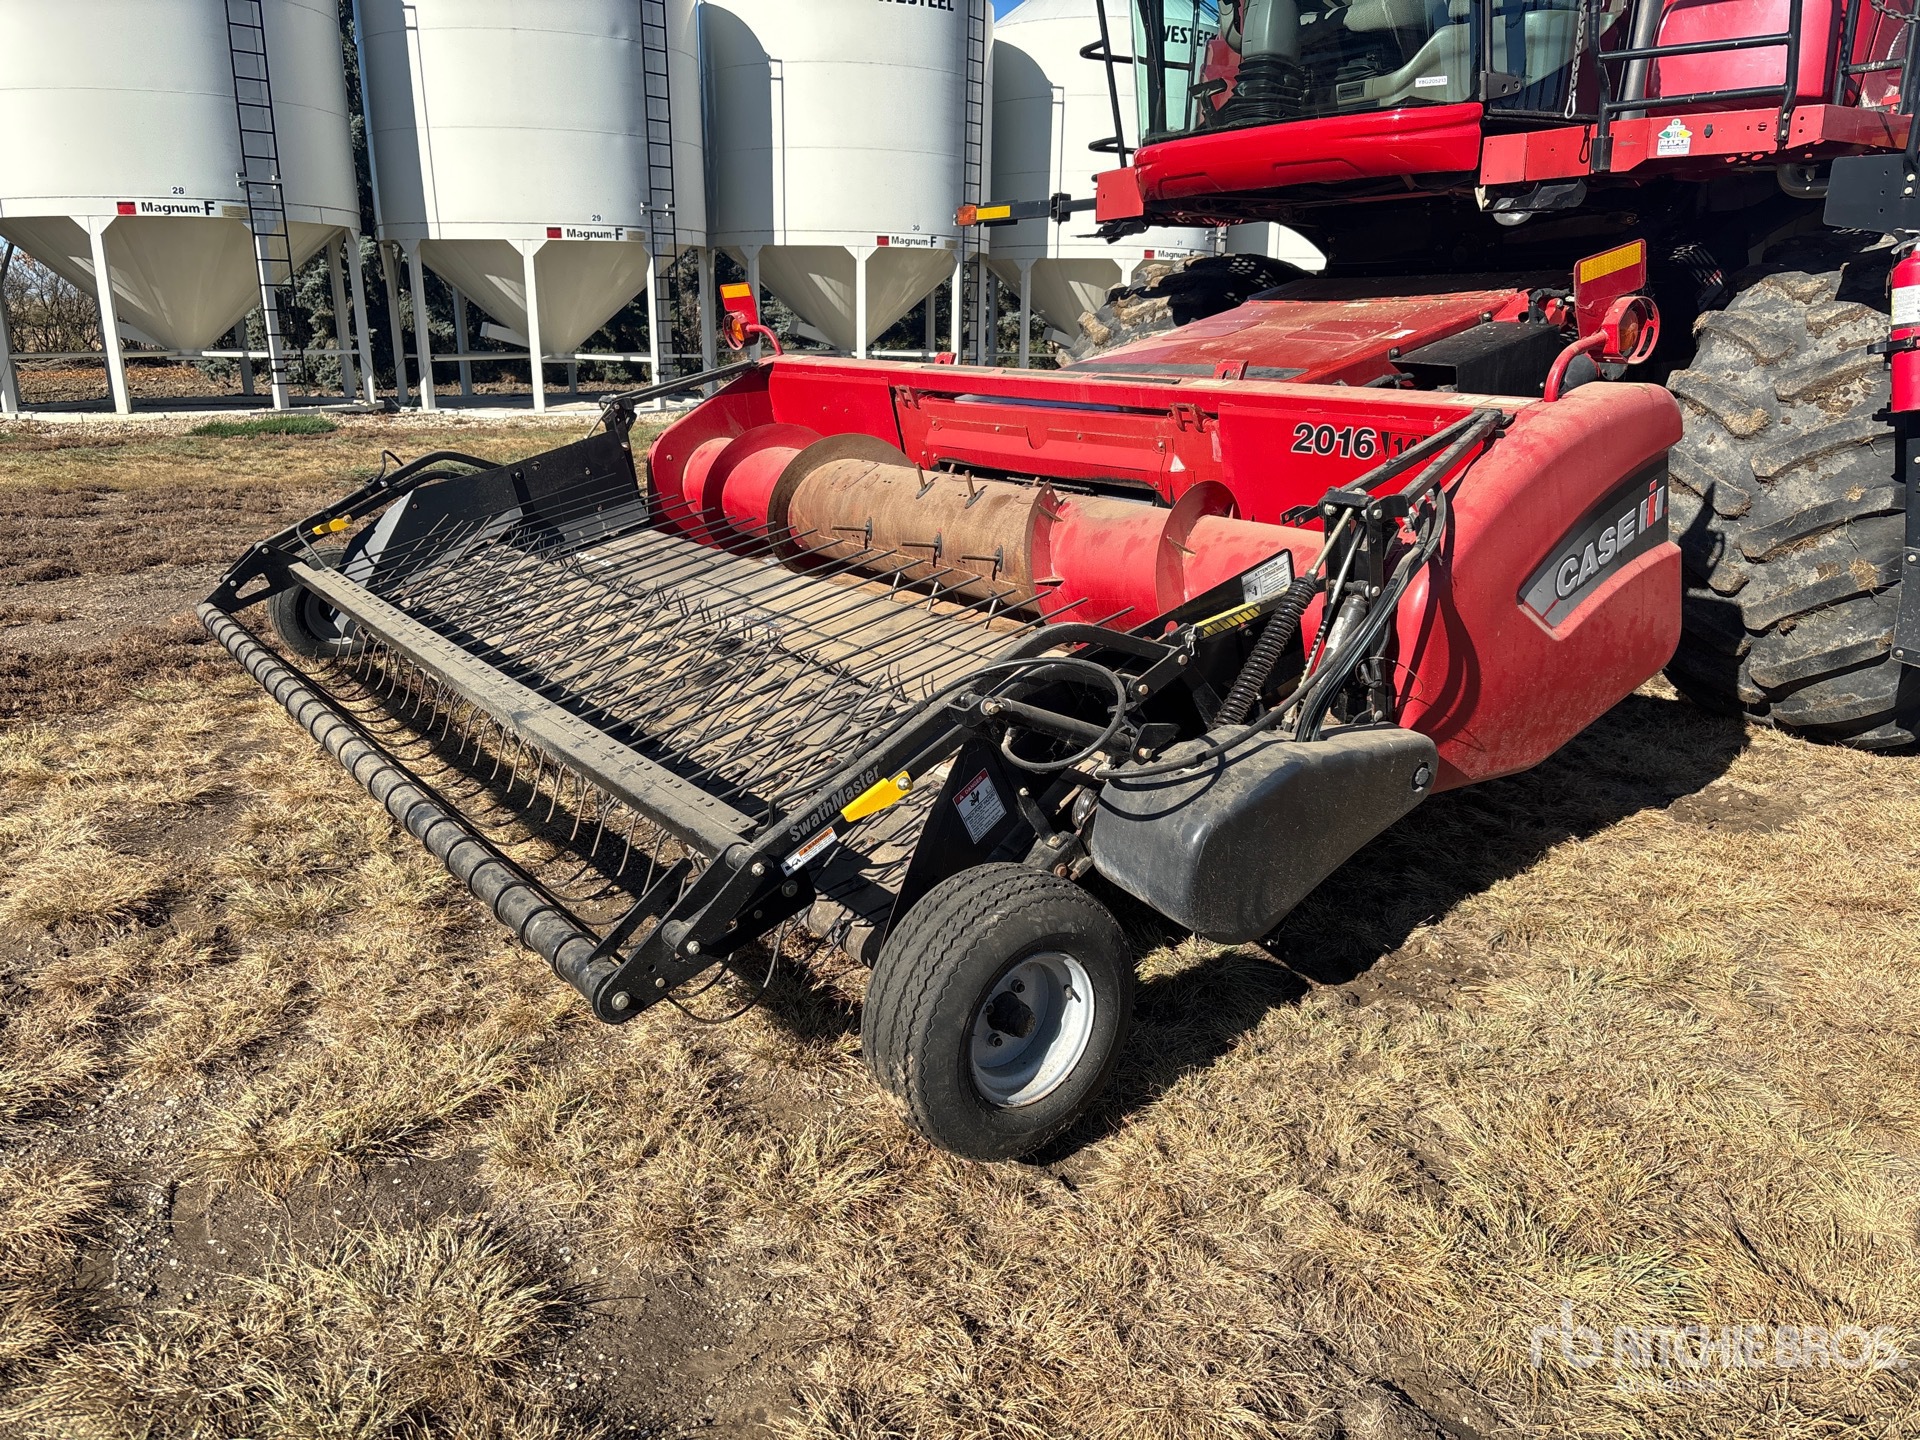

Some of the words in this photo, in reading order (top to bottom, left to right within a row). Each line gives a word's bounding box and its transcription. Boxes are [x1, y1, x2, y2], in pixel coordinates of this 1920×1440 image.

[172, 186, 185, 195] 28
[141, 201, 215, 215] Magnum-F
[566, 228, 623, 241] Magnum-F
[891, 236, 937, 248] Magnum-F
[1291, 422, 1377, 461] 2016
[1556, 507, 1637, 598] CASE
[964, 775, 984, 795] DANGER
[789, 764, 881, 842] SwathMaster
